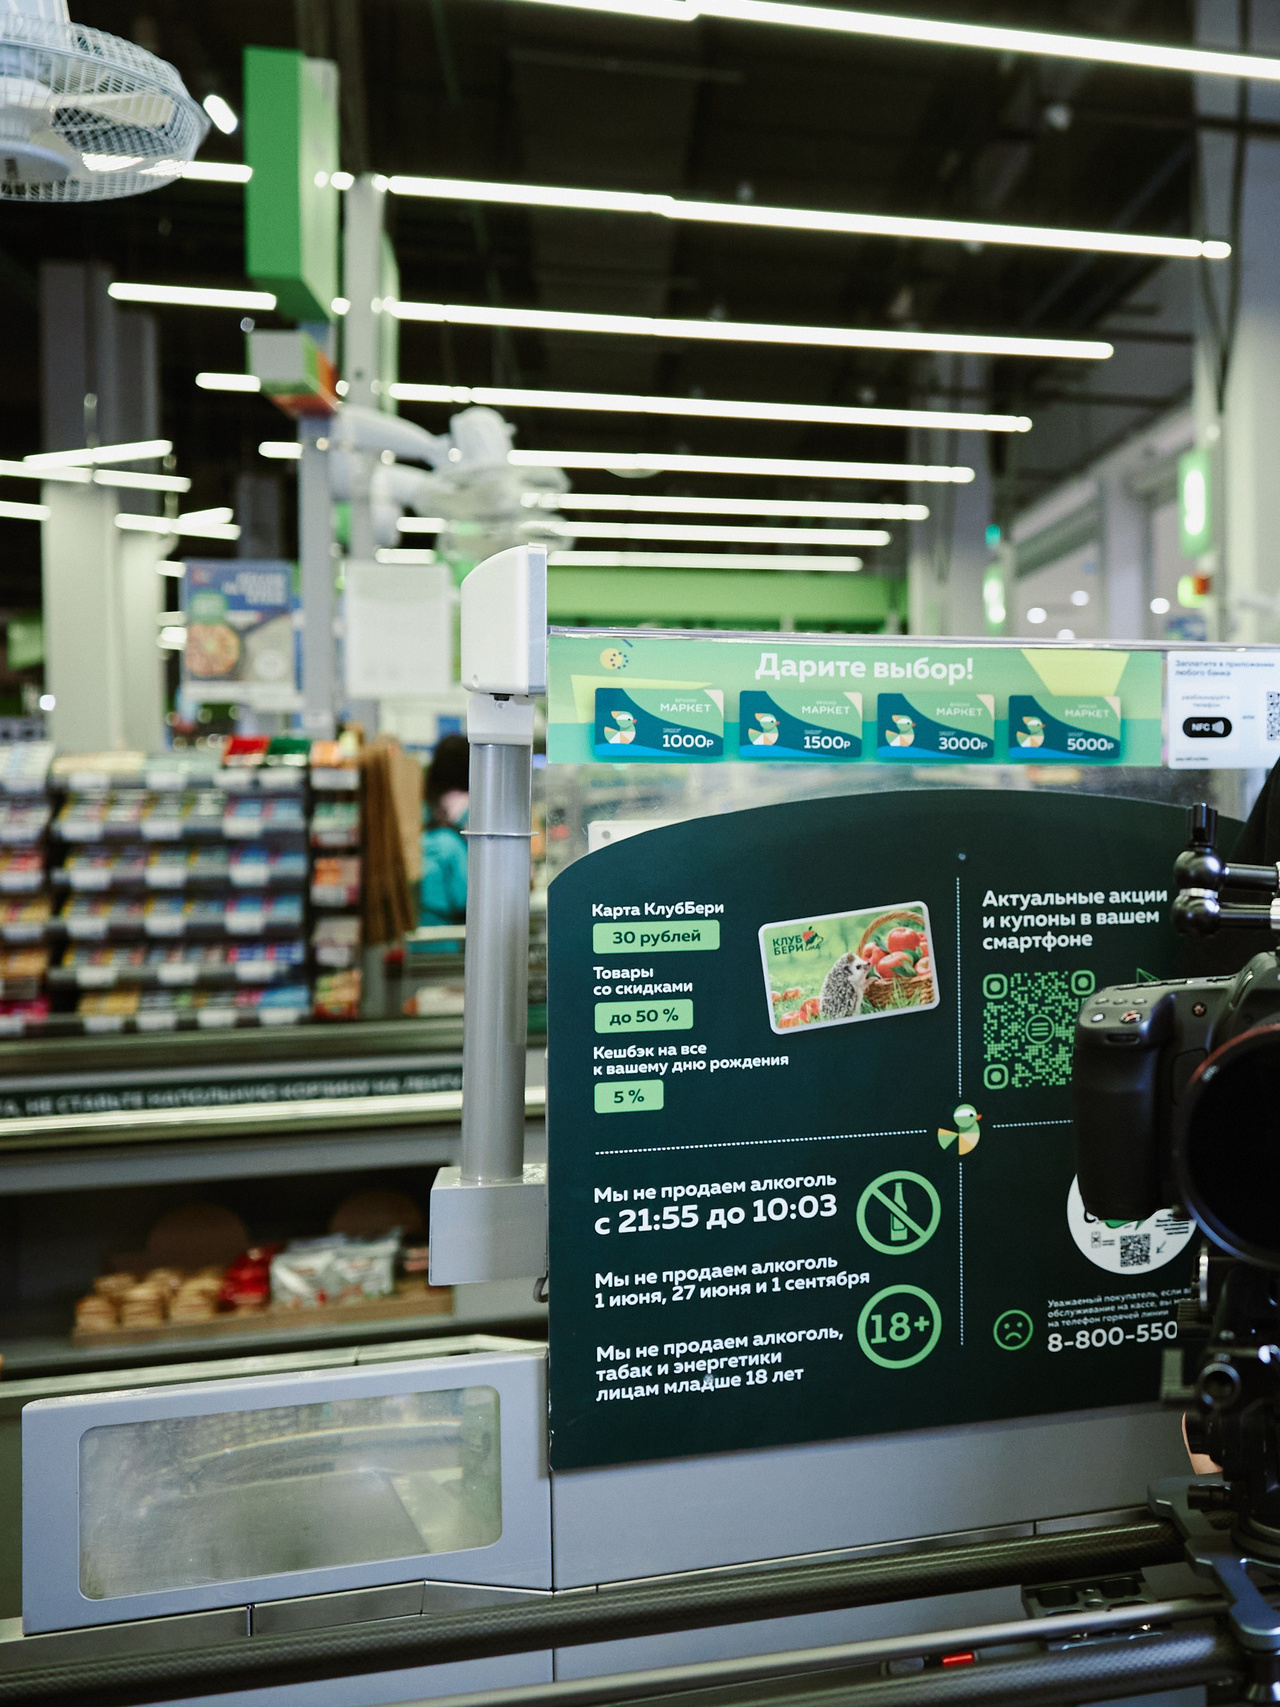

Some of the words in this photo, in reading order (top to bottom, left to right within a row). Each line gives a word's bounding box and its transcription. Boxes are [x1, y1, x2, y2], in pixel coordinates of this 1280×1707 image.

[755, 652, 867, 682] Дарите
[874, 656, 974, 686] выбор!
[660, 703, 711, 713] МАРКЕТ
[801, 705, 850, 715] МАРКЕТ
[936, 707, 983, 716] МАРКЕТ
[1065, 709, 1110, 718] МАРКЕТ
[982, 890, 1105, 911] Актуальные
[1109, 889, 1168, 905] акции
[592, 903, 641, 919] Карта
[644, 901, 725, 918] КлубБери
[982, 916, 995, 928] и
[1000, 913, 1076, 932] купоны
[1080, 913, 1092, 925] в
[1096, 910, 1160, 925] вашем
[612, 931, 636, 944] 30
[640, 928, 701, 947] рублей
[772, 934, 803, 947] КЛУБ
[982, 931, 1093, 953] смартфоне
[774, 944, 804, 956] БЕРИ
[593, 966, 654, 983] Товары
[593, 985, 611, 996] со
[615, 981, 693, 997] скидками
[609, 1011, 634, 1026] до
[636, 1010, 659, 1023] 50
[663, 1008, 679, 1022] %
[593, 1045, 654, 1060] Кешбэк
[658, 1046, 676, 1057] на
[680, 1044, 707, 1056] все
[593, 1065, 603, 1076] к
[606, 1061, 668, 1076] вашему
[672, 1058, 706, 1073] дню
[710, 1055, 789, 1073] рождения
[613, 1090, 624, 1104] 5
[628, 1089, 645, 1103] %
[593, 1186, 628, 1204] Мы
[632, 1185, 657, 1200] не
[660, 1180, 747, 1204] продаем
[750, 1173, 837, 1193] алкоголь
[593, 1216, 611, 1235] с
[618, 1204, 699, 1234] 21:55
[705, 1206, 746, 1230] до
[752, 1193, 838, 1223] 10:03
[594, 1272, 629, 1289] Мы
[634, 1269, 658, 1285] не
[662, 1263, 748, 1287] продаем
[751, 1256, 838, 1277] алкоголь
[594, 1292, 605, 1308] 1
[609, 1289, 667, 1307] июня,
[672, 1285, 696, 1302] 27
[700, 1281, 751, 1300] июня
[756, 1279, 767, 1294] и
[771, 1276, 781, 1292] 1
[785, 1270, 870, 1292] сентября
[1047, 1294, 1102, 1308] Уважаемый
[1104, 1290, 1159, 1303] покупатель,
[1160, 1288, 1182, 1296] если
[1047, 1304, 1116, 1318] обслуживание
[1117, 1303, 1129, 1311] на
[1130, 1301, 1158, 1310] кассе,
[1048, 1320, 1060, 1328] на
[1061, 1316, 1101, 1326] телефон
[1102, 1312, 1139, 1324] горячей
[1141, 1309, 1169, 1318] линии
[870, 1310, 930, 1345] 18+
[1047, 1320, 1178, 1353] 8-800-550
[596, 1345, 631, 1362] Мы
[635, 1342, 660, 1358] не
[663, 1336, 749, 1360] продаем
[752, 1326, 844, 1348] алкоголь,
[596, 1364, 652, 1382] табак
[658, 1361, 669, 1376] и
[673, 1350, 782, 1375] энергетики
[595, 1385, 659, 1402] лицам
[663, 1374, 742, 1395] младше
[745, 1369, 768, 1386] 18
[771, 1366, 804, 1382] лет
